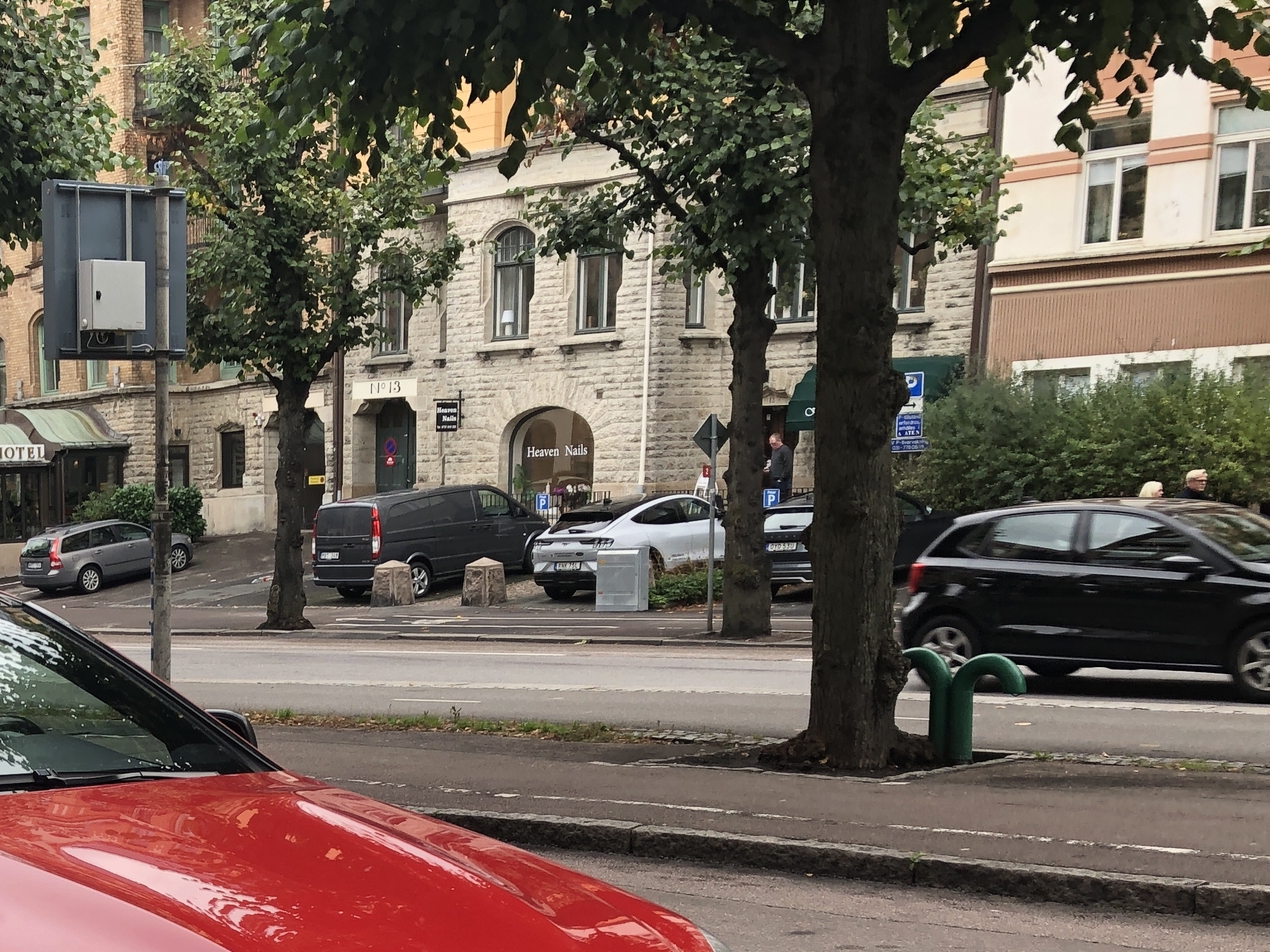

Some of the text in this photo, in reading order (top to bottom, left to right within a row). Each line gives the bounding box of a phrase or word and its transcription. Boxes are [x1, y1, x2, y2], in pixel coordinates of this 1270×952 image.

[389, 380, 401, 393] 13
[527, 443, 588, 458] Heaven Nails
[539, 499, 546, 509] P
[767, 494, 776, 506] P
